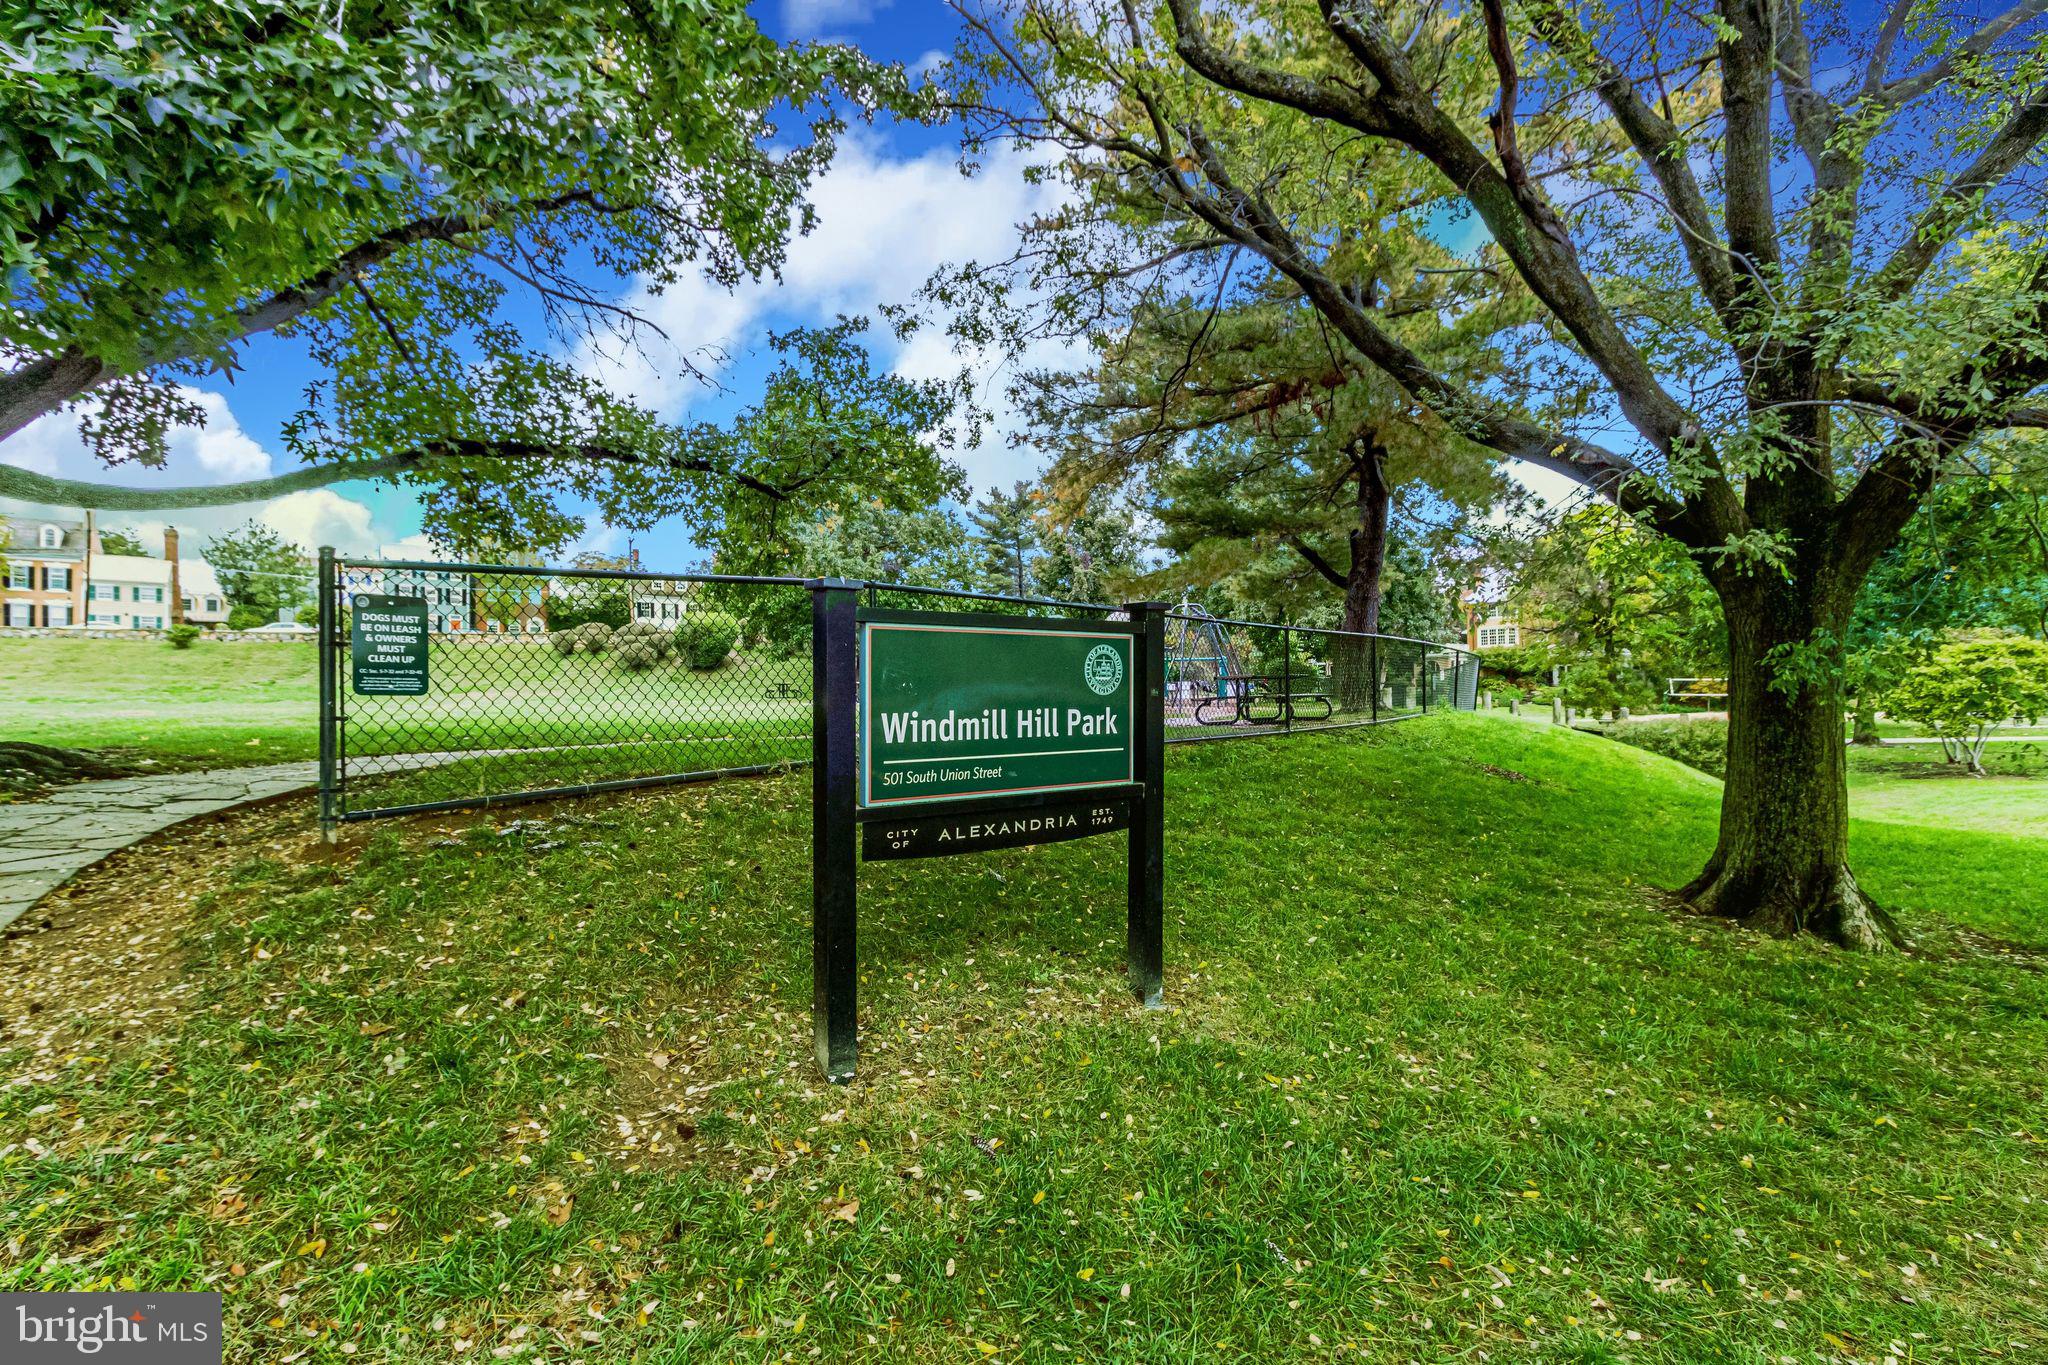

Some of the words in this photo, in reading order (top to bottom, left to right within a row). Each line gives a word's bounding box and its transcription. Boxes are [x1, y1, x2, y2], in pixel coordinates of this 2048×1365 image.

[361, 612, 390, 622] DOGS
[392, 615, 420, 624] MUST
[360, 623, 373, 631] BE
[374, 624, 390, 632] ON
[391, 625, 422, 634] LEASH
[365, 633, 373, 642] &
[374, 634, 417, 644] OWNERS
[377, 644, 406, 653] MUST
[367, 654, 400, 663] CLEAN
[401, 655, 416, 664] UP
[881, 708, 1008, 744] Windmill
[1017, 707, 1059, 738] Hill
[1067, 706, 1118, 736] Park
[882, 771, 904, 786] 501
[906, 768, 937, 784] South
[940, 766, 971, 782] Union
[972, 765, 1002, 779] Street
[1092, 808, 1114, 816] EST.
[1092, 816, 1114, 826] 1749
[886, 828, 918, 839] CITY
[938, 814, 1077, 842] ALEXANDRIA
[892, 840, 910, 849] OF
